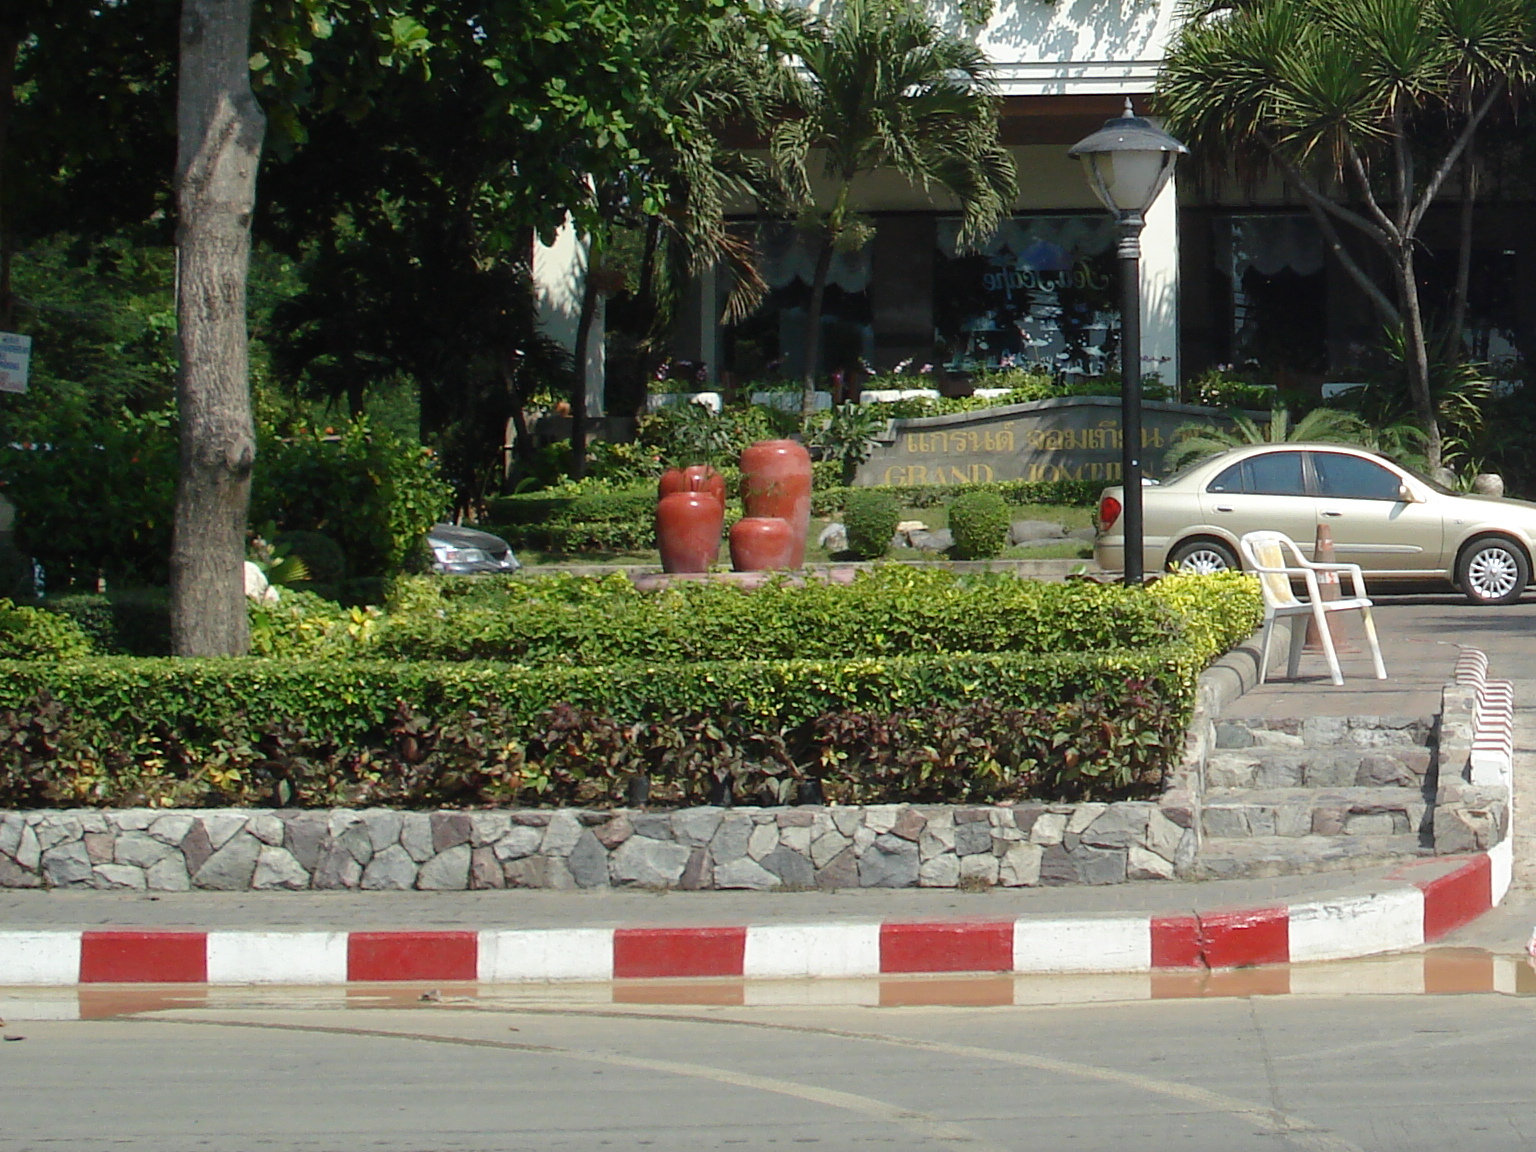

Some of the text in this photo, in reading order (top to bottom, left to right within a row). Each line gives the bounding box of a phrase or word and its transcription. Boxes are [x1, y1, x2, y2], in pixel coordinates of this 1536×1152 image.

[906, 421, 1015, 454] แกรนด์
[1026, 419, 1165, 452] จอมเทีน
[884, 463, 995, 486] GRAND
